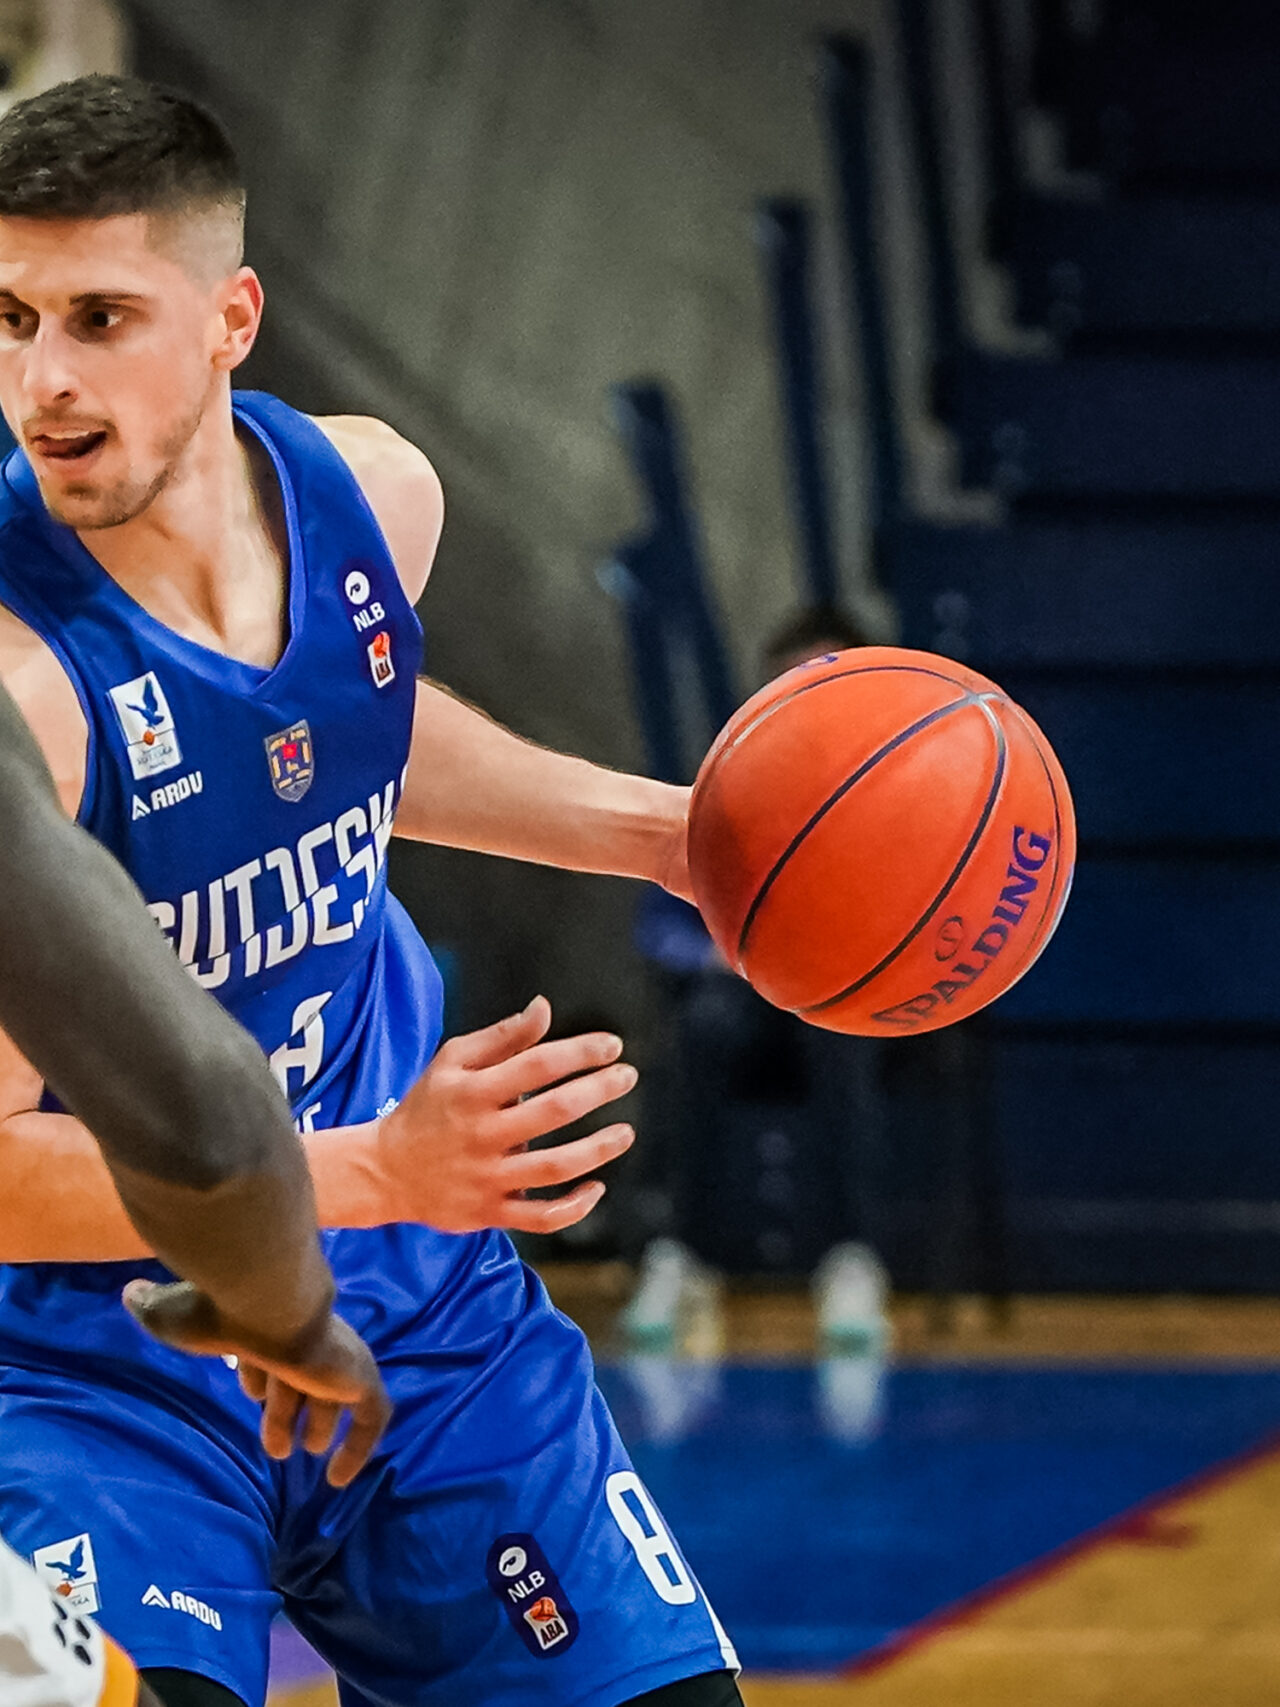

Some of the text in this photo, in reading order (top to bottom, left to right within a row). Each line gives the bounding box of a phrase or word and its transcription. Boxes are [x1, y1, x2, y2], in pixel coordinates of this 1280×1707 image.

[352, 601, 386, 633] NLB
[150, 770, 203, 811] ARDU
[870, 825, 1052, 1027] SPALDING
[606, 1471, 696, 1605] 8
[507, 1570, 545, 1603] NLB
[540, 1620, 566, 1646] ABA
